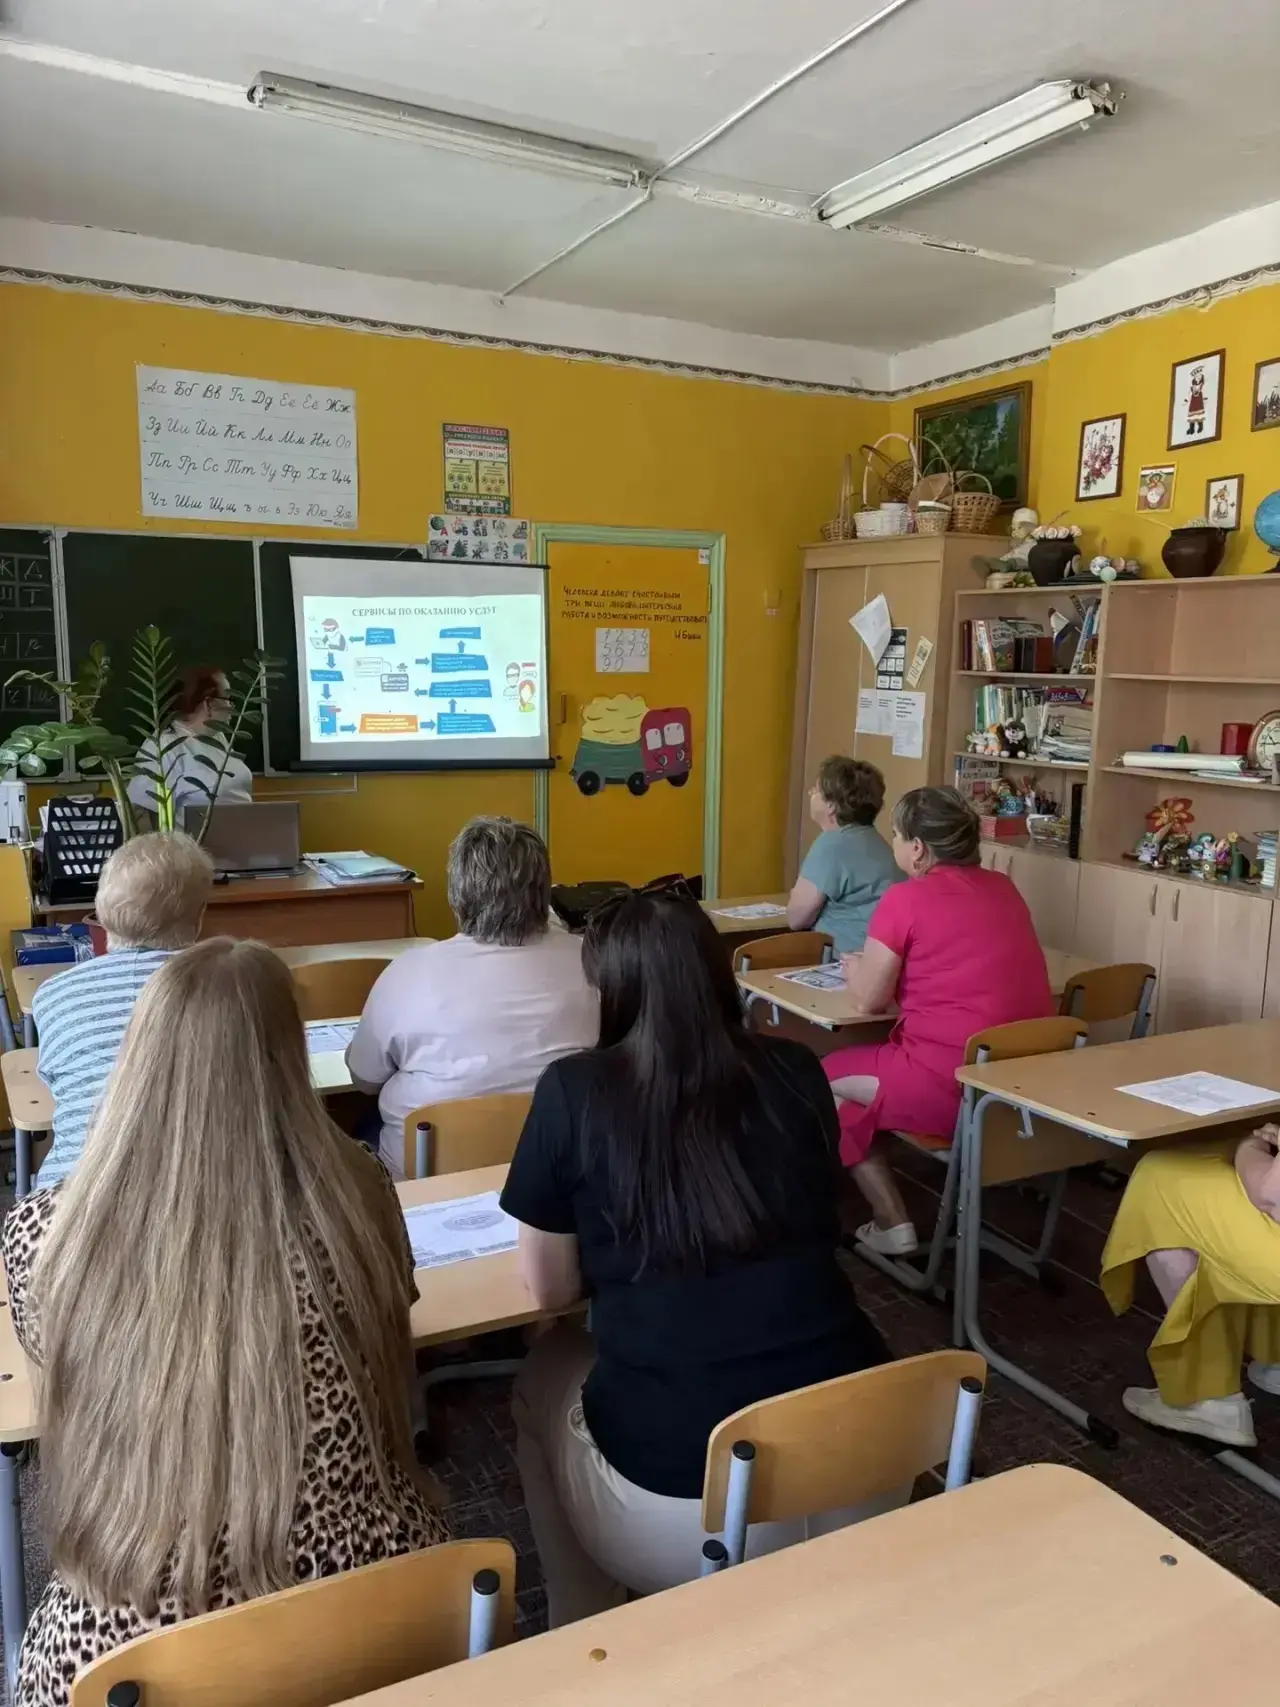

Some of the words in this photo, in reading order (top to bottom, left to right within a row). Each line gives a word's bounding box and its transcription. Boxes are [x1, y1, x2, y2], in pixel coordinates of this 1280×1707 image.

[144, 379, 167, 394] Аа
[174, 380, 200, 396] Бб
[203, 384, 222, 399] Вв
[229, 387, 245, 402] Гг
[251, 390, 273, 412] Дд
[280, 392, 296, 407] Ее
[325, 398, 351, 413] Жж
[146, 416, 161, 436] Зз
[167, 418, 190, 434] Ии
[196, 418, 219, 437] Йй
[224, 423, 247, 439] Кк
[251, 427, 274, 441] Лл
[278, 430, 305, 445] Мм
[310, 432, 332, 447] Нн
[336, 434, 352, 449] Оо
[148, 452, 172, 468] Пп
[177, 455, 198, 476] Рр
[203, 457, 219, 472] Сс
[224, 459, 256, 476] Тт
[261, 462, 277, 482] Уу
[281, 464, 301, 484] Фф
[306, 466, 328, 481] Хх
[331, 469, 352, 484] Цц
[148, 491, 168, 507] Чч
[174, 494, 203, 509] Шш
[209, 496, 237, 513] Щщ
[287, 502, 300, 516] Ээ
[306, 503, 328, 517] Юю
[333, 504, 353, 520] Яя
[440, 527, 448, 536] А
[462, 527, 469, 536] Б
[482, 528, 488, 537] В
[472, 549, 482, 560] Ж
[502, 549, 509, 560] З
[24, 560, 43, 580] Д
[22, 588, 43, 604] Т
[352, 607, 397, 617] СЕРВИСЫ
[398, 607, 412, 616] ПО
[414, 607, 467, 616] ОКАЗАНИЮ
[469, 606, 498, 615] УСЛУГ
[562, 610, 589, 619] РАБОТА
[615, 629, 623, 643] 2
[627, 630, 637, 643] 3
[602, 643, 611, 657] 5
[615, 643, 624, 657] 6
[602, 656, 611, 672] 9
